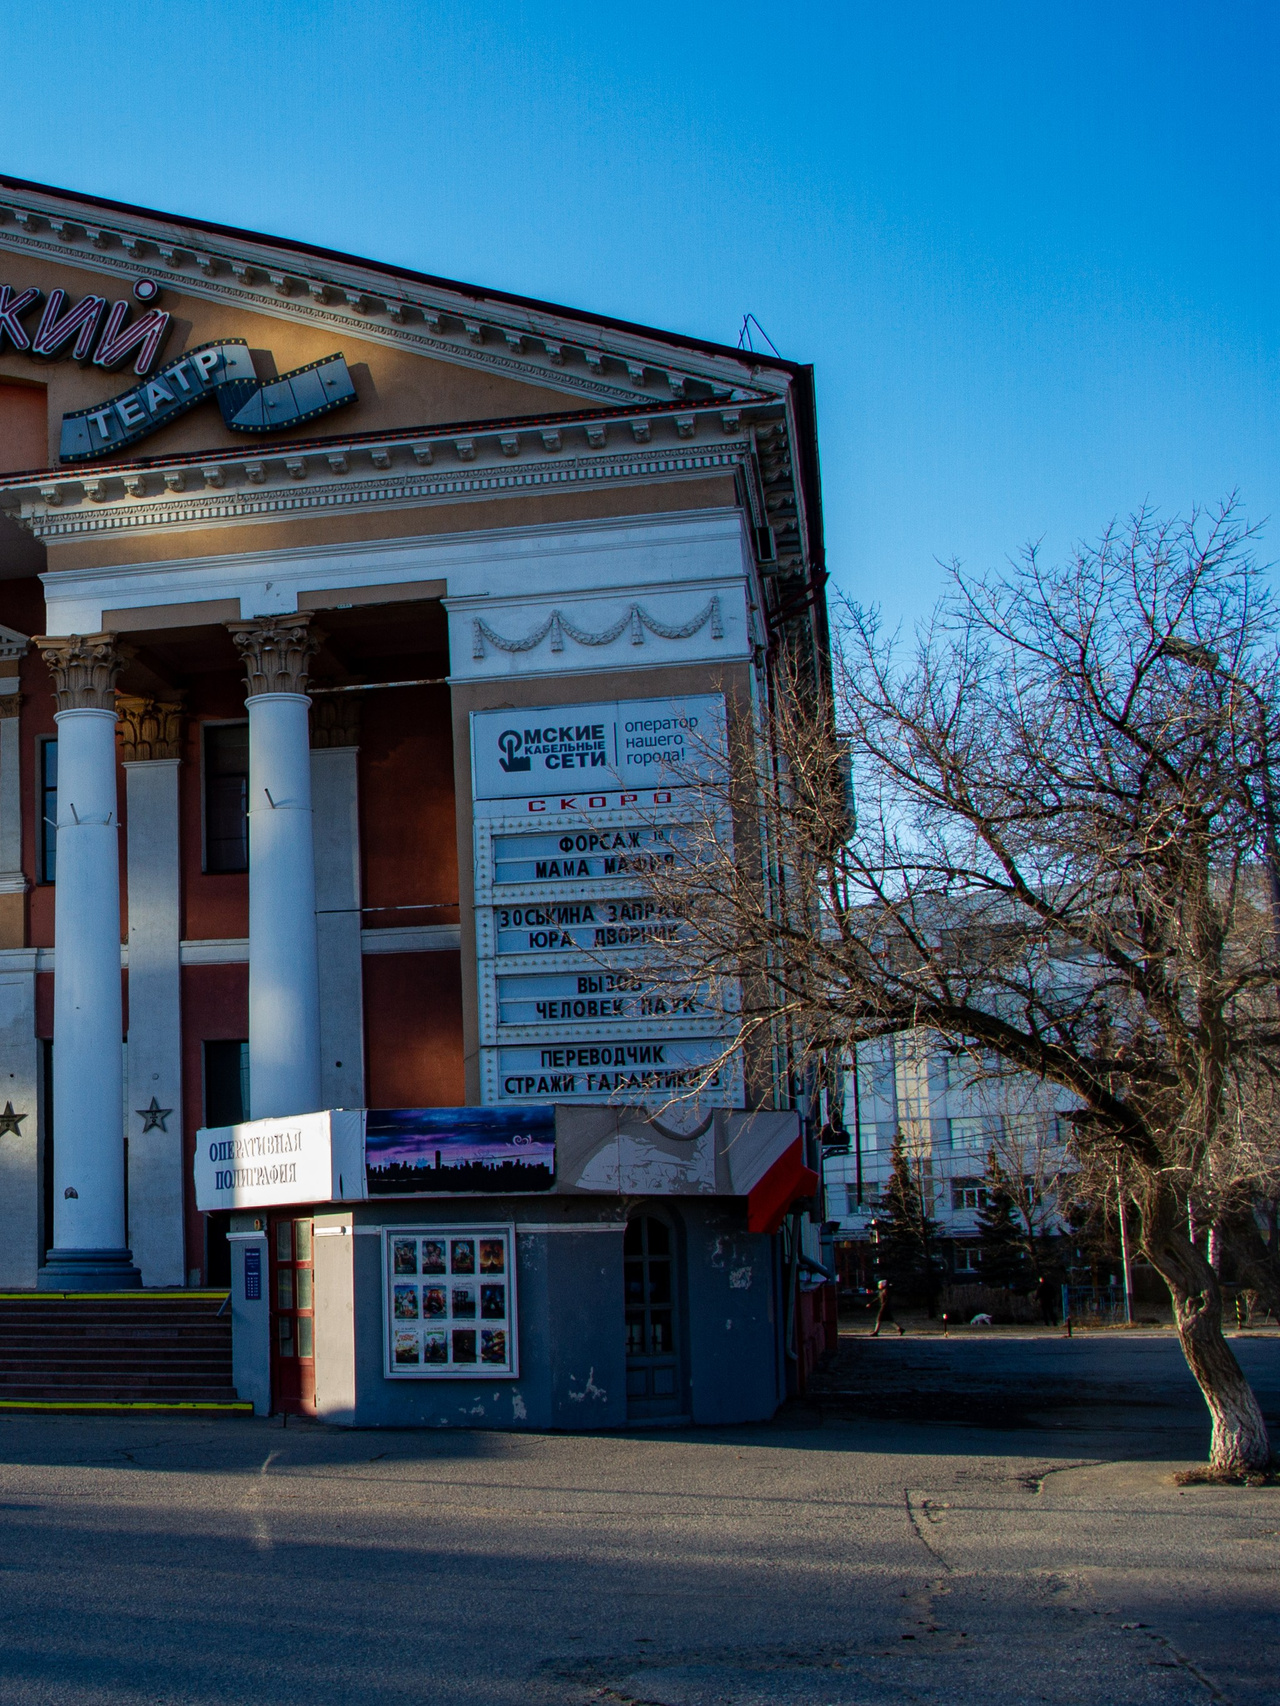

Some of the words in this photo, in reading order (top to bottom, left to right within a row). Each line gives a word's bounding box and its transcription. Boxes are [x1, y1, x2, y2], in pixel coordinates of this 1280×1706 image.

[86, 350, 219, 441] ТЕАТР
[624, 716, 698, 736] оператор
[524, 741, 605, 755] КАБЕЛЬНЫЕ
[626, 733, 684, 749] нашего
[545, 751, 606, 770] СЕТИ
[626, 748, 685, 767] города!
[528, 792, 672, 812] СКОРО
[559, 832, 641, 853] ФОРСАЖ
[535, 859, 590, 879] МАМА
[529, 930, 572, 949] ЮРА
[577, 974, 643, 994] ВЫЗОВ
[536, 998, 624, 1019] ЧЕЛОВЕК
[641, 997, 697, 1016] ПАУК
[541, 1046, 665, 1068] ПЕРЕВОДЧИК
[504, 1075, 575, 1094] СТРАЖИ
[587, 1070, 701, 1091] ГАЛАКТИКИ
[710, 1071, 720, 1087] 3
[209, 1131, 302, 1162] ОПЕРАТИВНАЯ
[215, 1162, 297, 1190] ПОЛИГРАФИЯ
